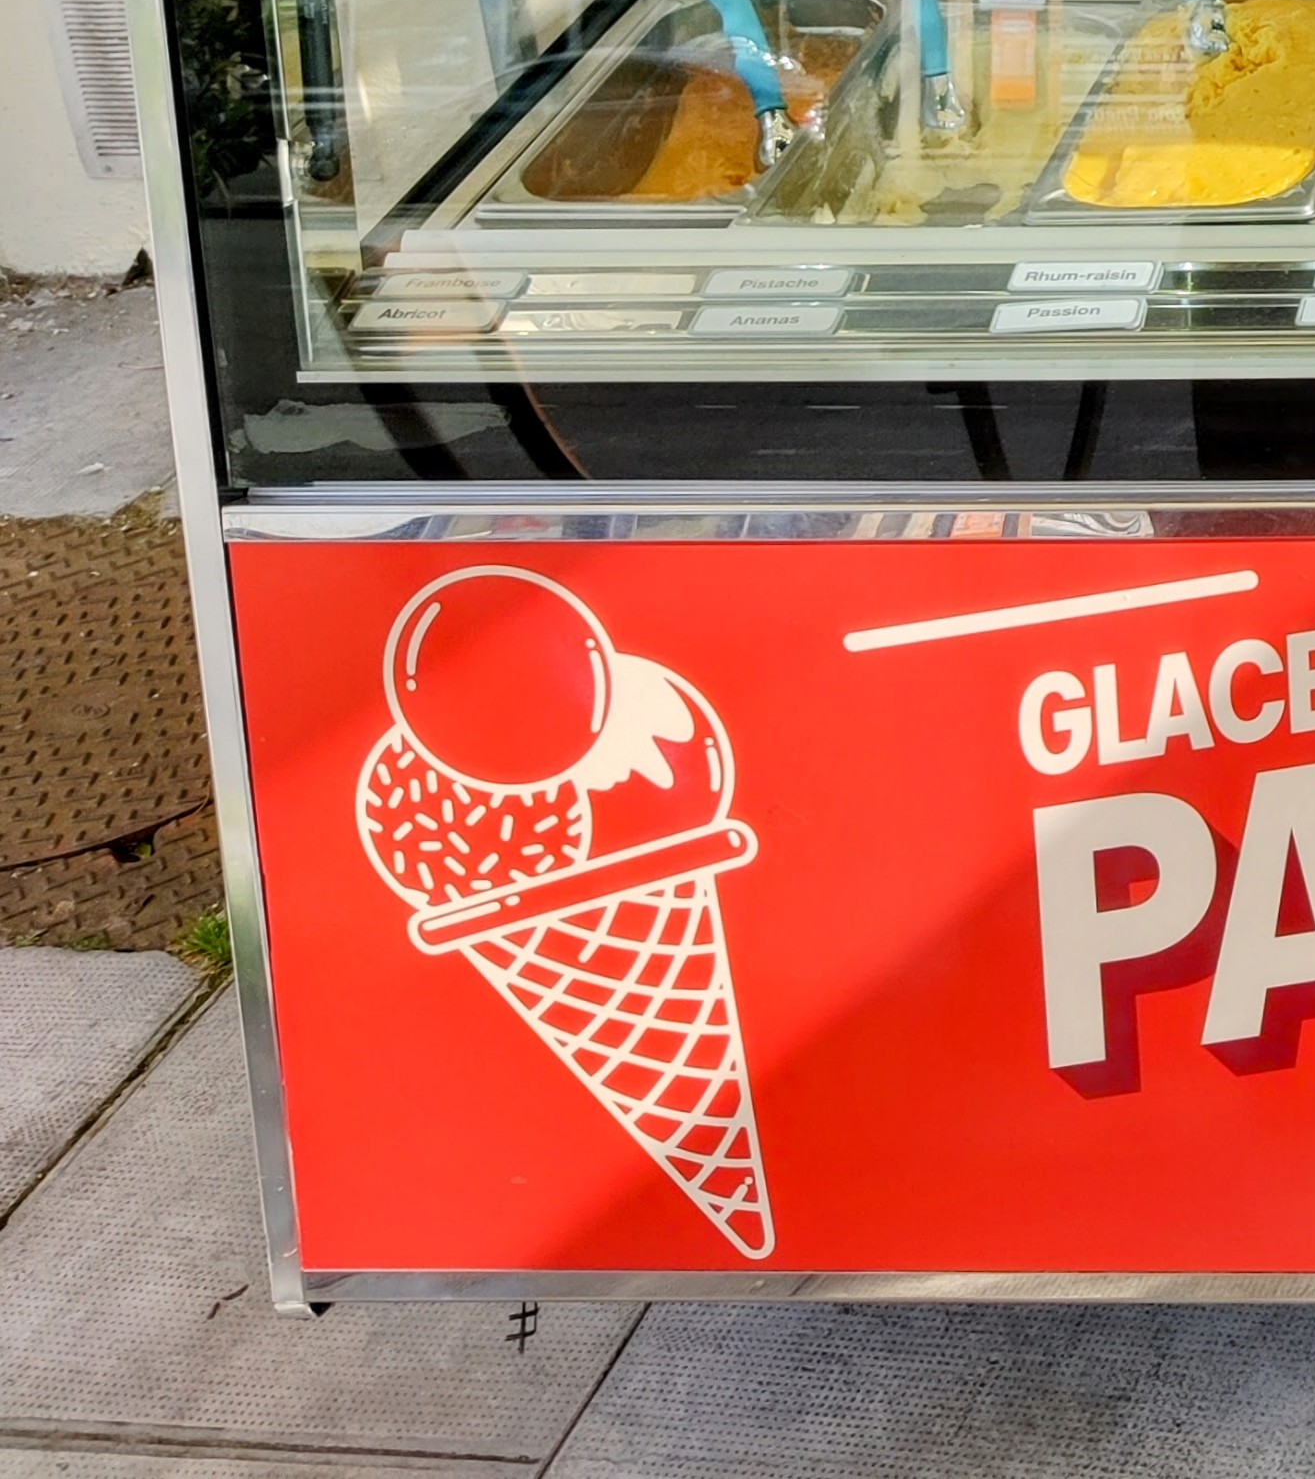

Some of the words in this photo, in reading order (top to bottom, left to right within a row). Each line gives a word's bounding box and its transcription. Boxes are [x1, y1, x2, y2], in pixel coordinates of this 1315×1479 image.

[739, 275, 819, 290] Pistache
[1024, 268, 1137, 284] Rhum-raisin
[378, 307, 446, 321] Abricot
[1027, 303, 1101, 319] Passion
[729, 313, 800, 327] Ananas
